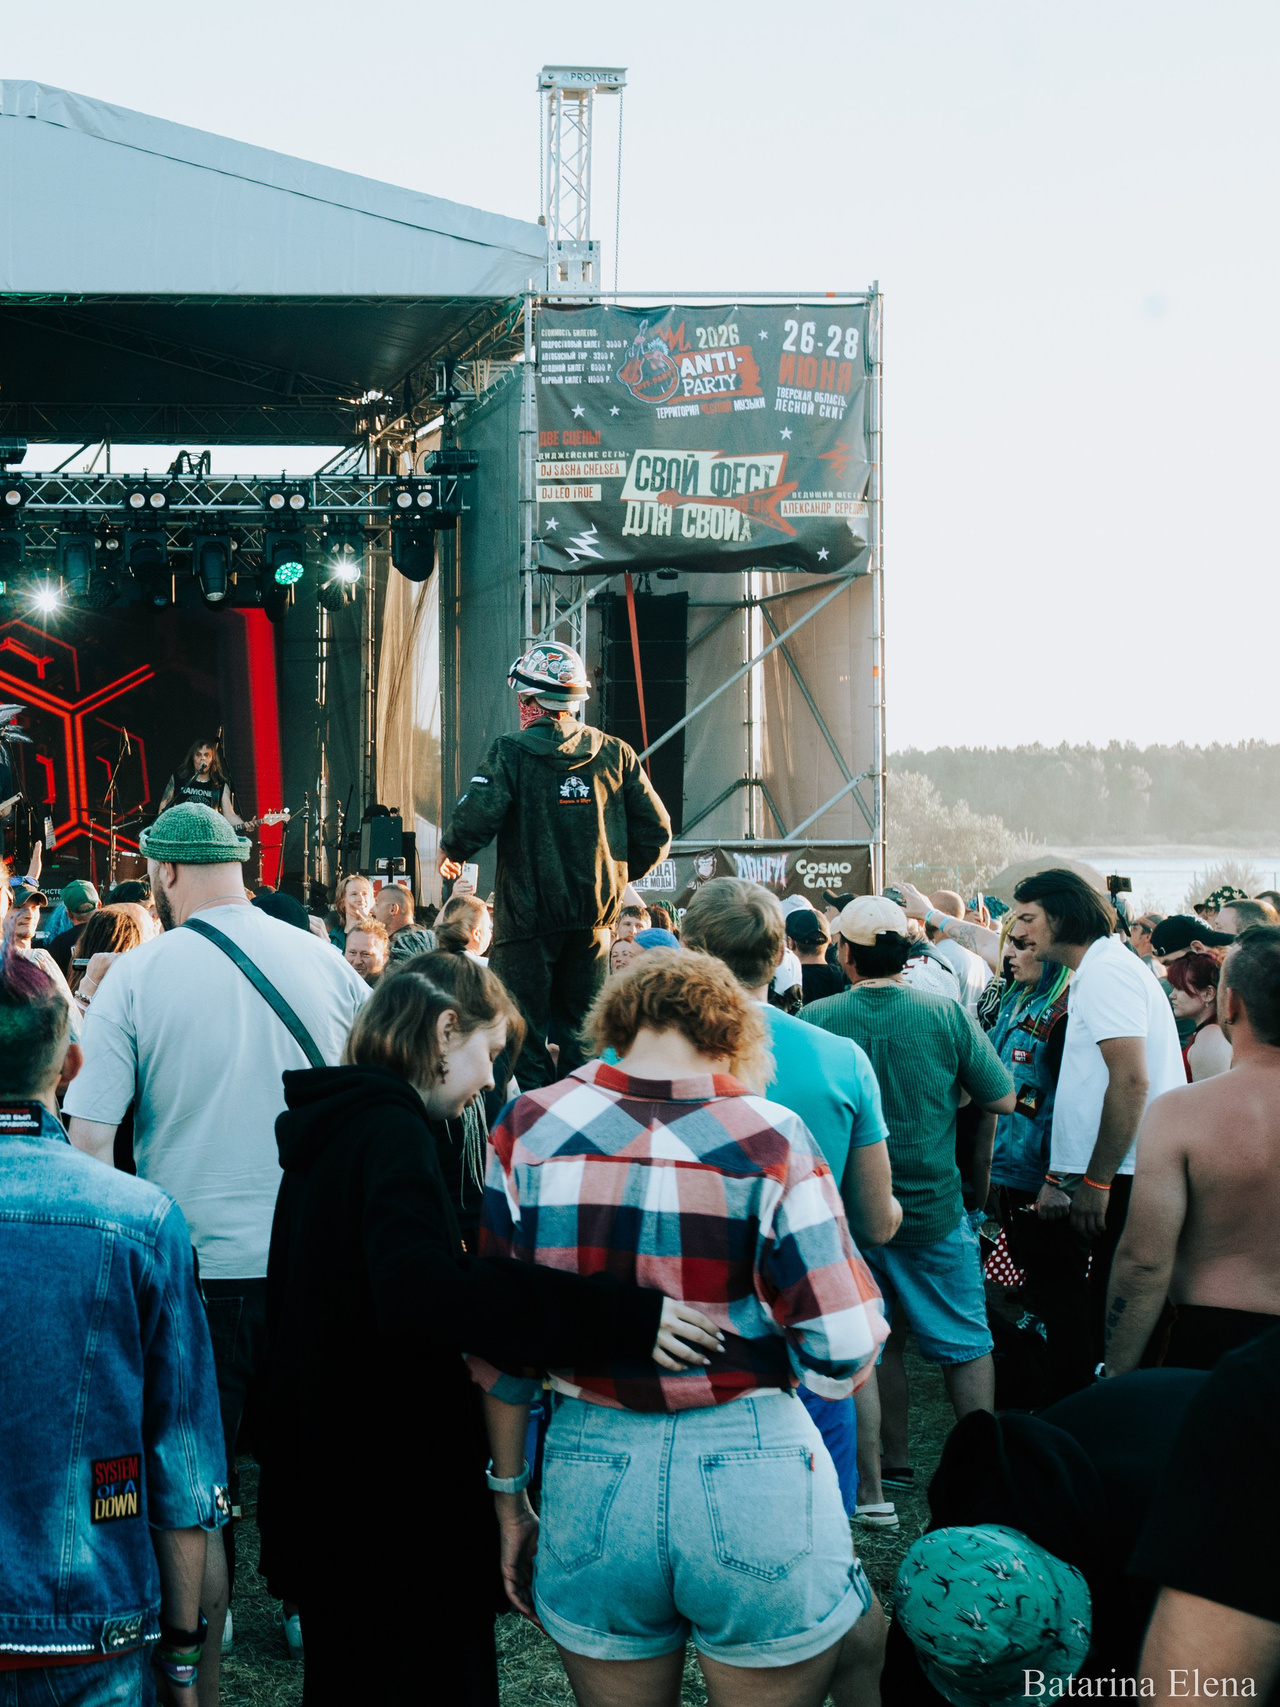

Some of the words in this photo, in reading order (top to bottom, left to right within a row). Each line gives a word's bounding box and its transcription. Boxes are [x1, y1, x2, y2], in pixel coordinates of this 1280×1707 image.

[570, 73, 613, 82] PROLYTE
[696, 324, 740, 349] 2026
[782, 319, 859, 360] 26-28
[583, 341, 601, 349] БИЛЕТ
[567, 364, 585, 373] БИЛЕТ
[778, 354, 852, 394] ИЮНЯ
[565, 376, 583, 384] БИЛЕТ
[682, 374, 737, 397] PARTY
[776, 387, 812, 402] ТВЕРСКАЯ
[656, 404, 699, 419] ТЕРРИТОРИЯ
[733, 398, 766, 412] МУЗЫКИ
[774, 399, 814, 415] ЛЕСНОЙ
[819, 405, 845, 420] СКИТ
[539, 431, 559, 447] ДВЕ
[538, 451, 599, 460] ДИДЖЕЙСКИЕ
[541, 464, 552, 476] DJ
[554, 464, 581, 476] SASHA
[583, 463, 620, 475] CHELSEA
[634, 454, 699, 496] СВОЙ
[711, 462, 775, 497] ФЕСТ
[542, 487, 553, 499] DJ
[555, 487, 570, 499] LEO
[573, 486, 594, 498] TRUE
[783, 502, 832, 515] АЛЕКСАНДР
[621, 501, 672, 537] ДЛЯ
[795, 860, 852, 876] COSMO
[650, 878, 671, 888] МОДЫ
[803, 874, 843, 889] CATS
[95, 1457, 138, 1485] SYSTEM
[97, 1484, 122, 1498] OF
[124, 1480, 136, 1494] A
[95, 1492, 137, 1520] DOWN
